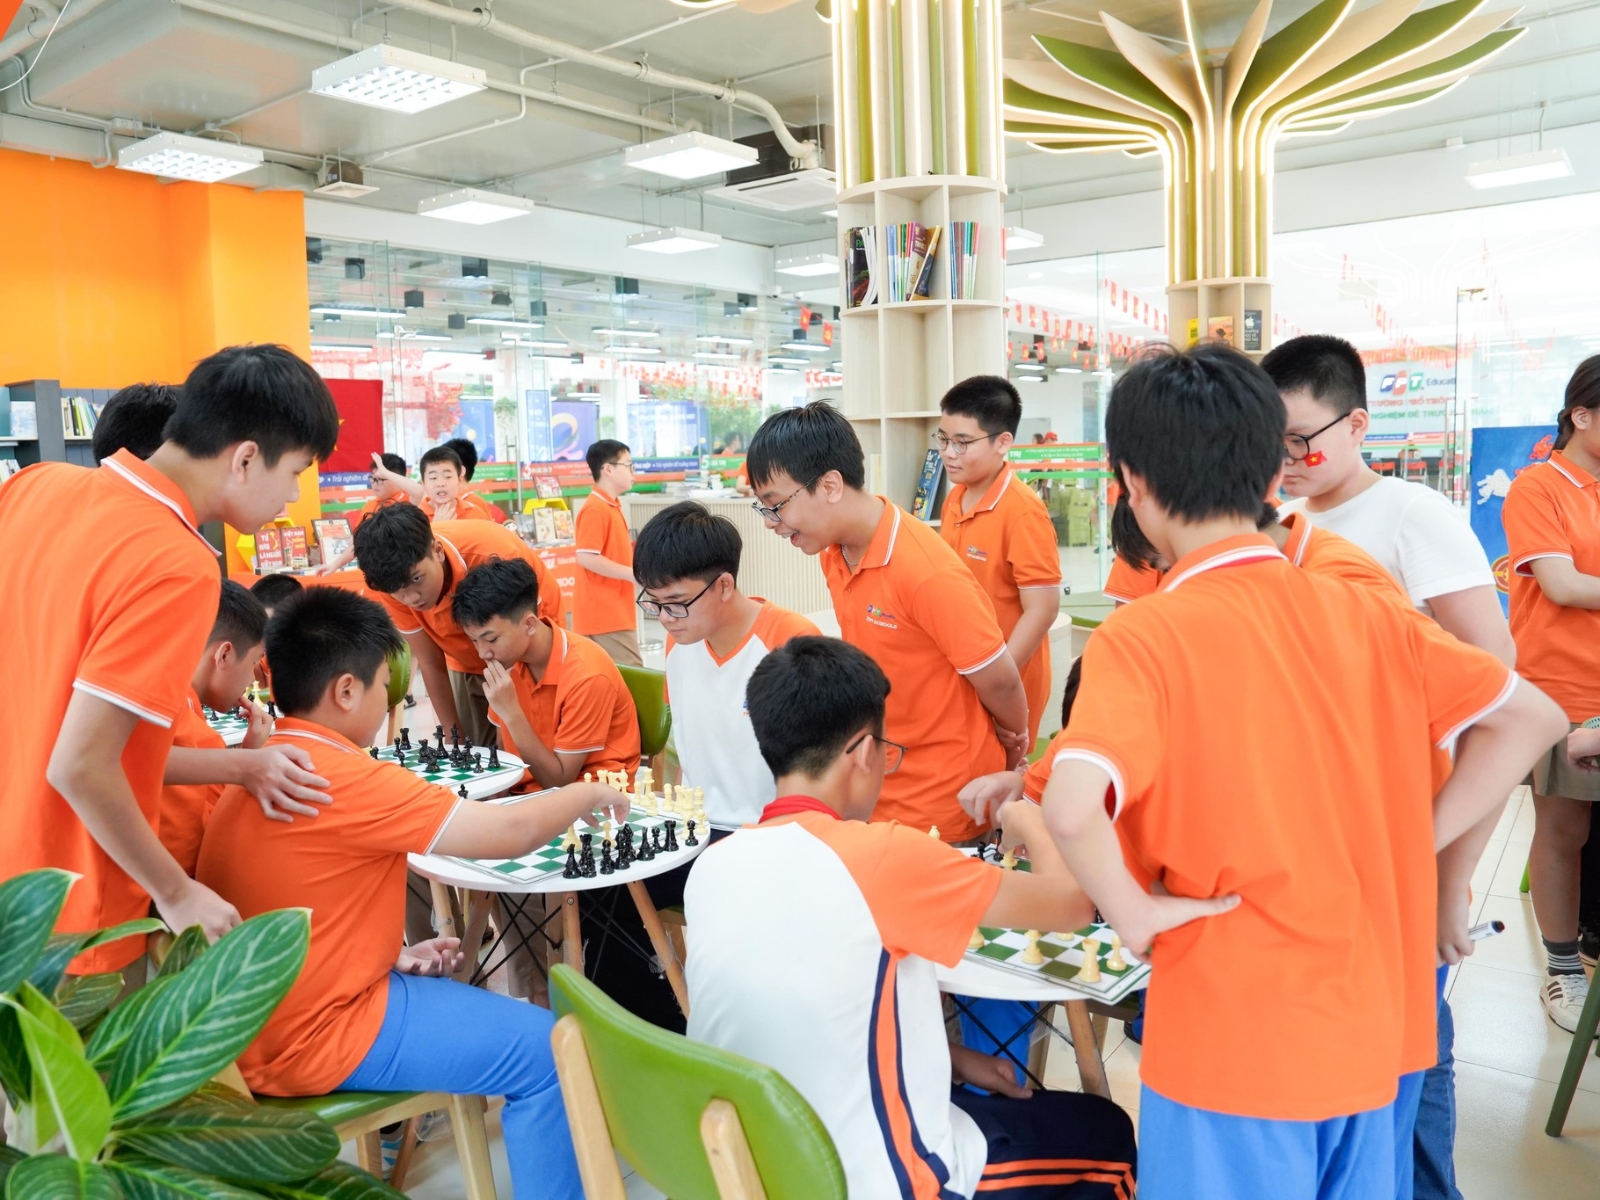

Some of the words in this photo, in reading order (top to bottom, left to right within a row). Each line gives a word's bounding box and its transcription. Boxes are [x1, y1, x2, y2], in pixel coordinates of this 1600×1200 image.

[1381, 373, 1423, 393] FPT
[1426, 377, 1456, 387] Educat
[701, 454, 710, 470] 5
[1009, 450, 1022, 459] TRỊ
